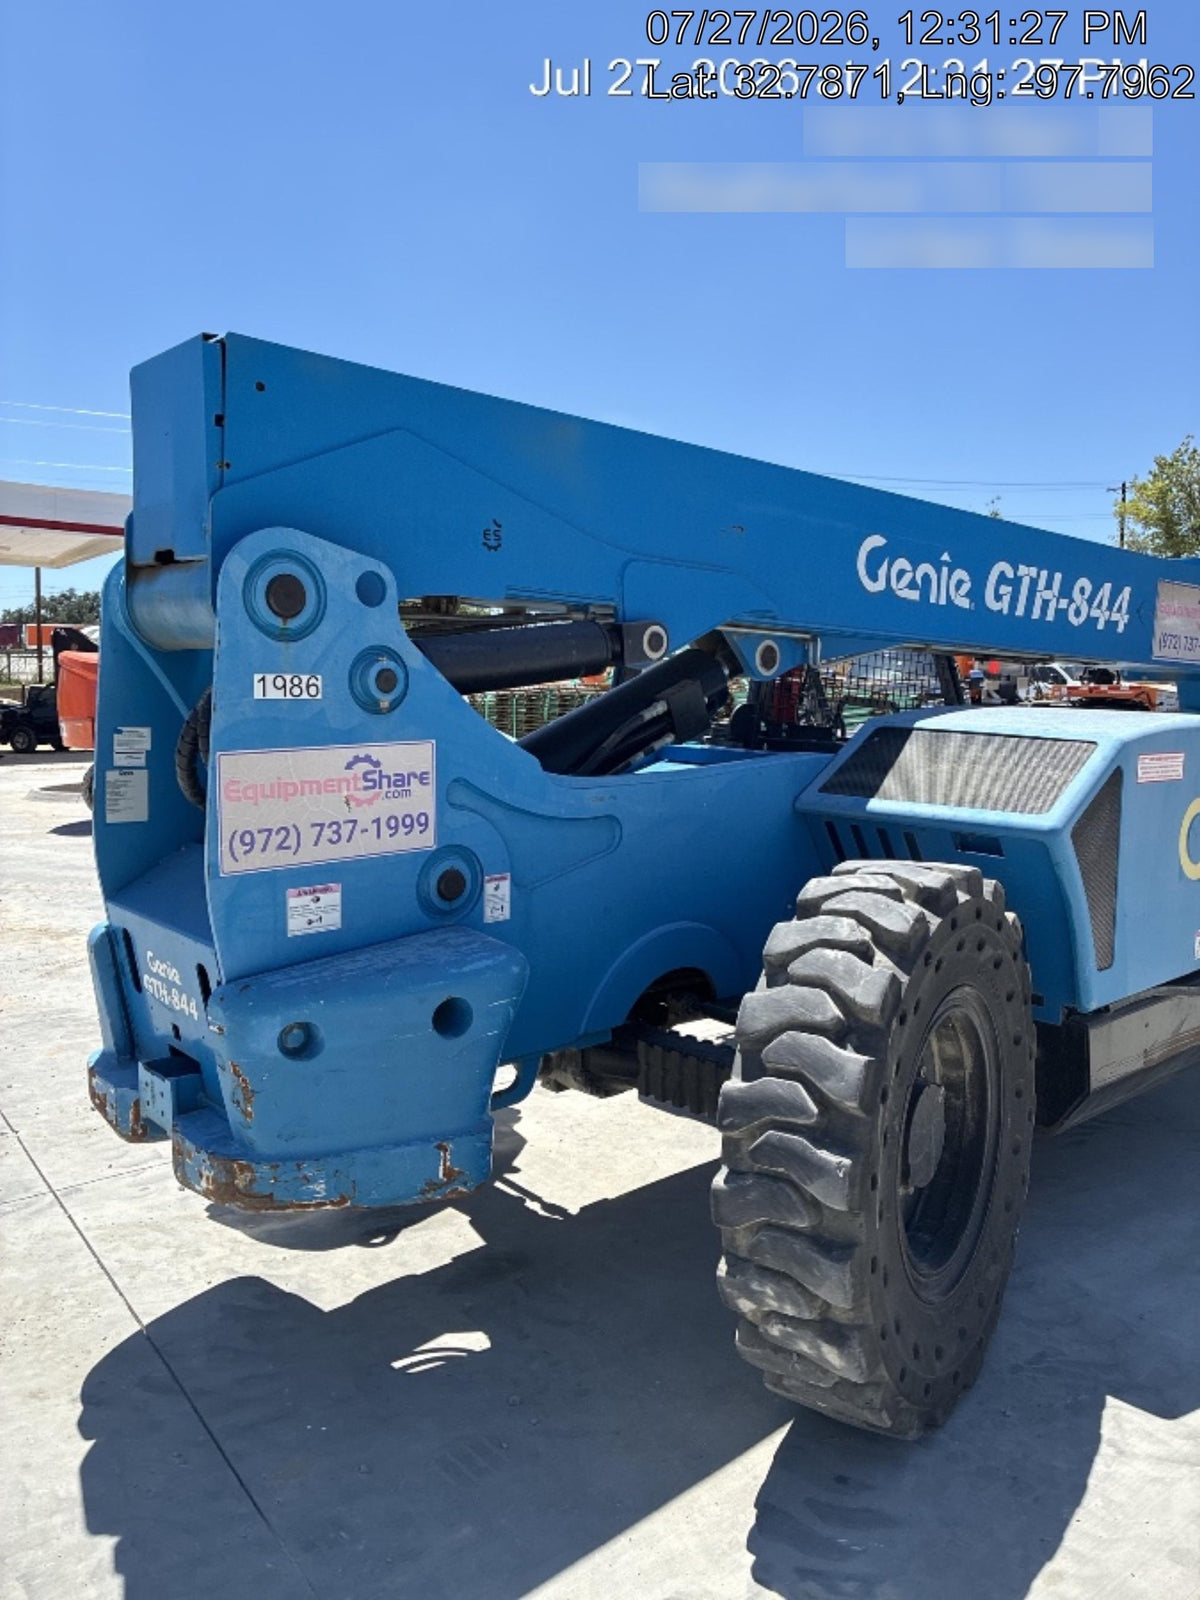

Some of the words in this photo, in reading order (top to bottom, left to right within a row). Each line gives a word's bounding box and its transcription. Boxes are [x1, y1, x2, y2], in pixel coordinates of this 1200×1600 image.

[857, 534, 976, 611] Genie
[984, 561, 1133, 634] GTH-844
[257, 675, 320, 698] 1986
[223, 769, 431, 806] EquipmentShare
[228, 823, 302, 863] (972)
[310, 811, 430, 848] 737-1999
[146, 950, 182, 986] Genie
[143, 973, 198, 1021] GTH-844
